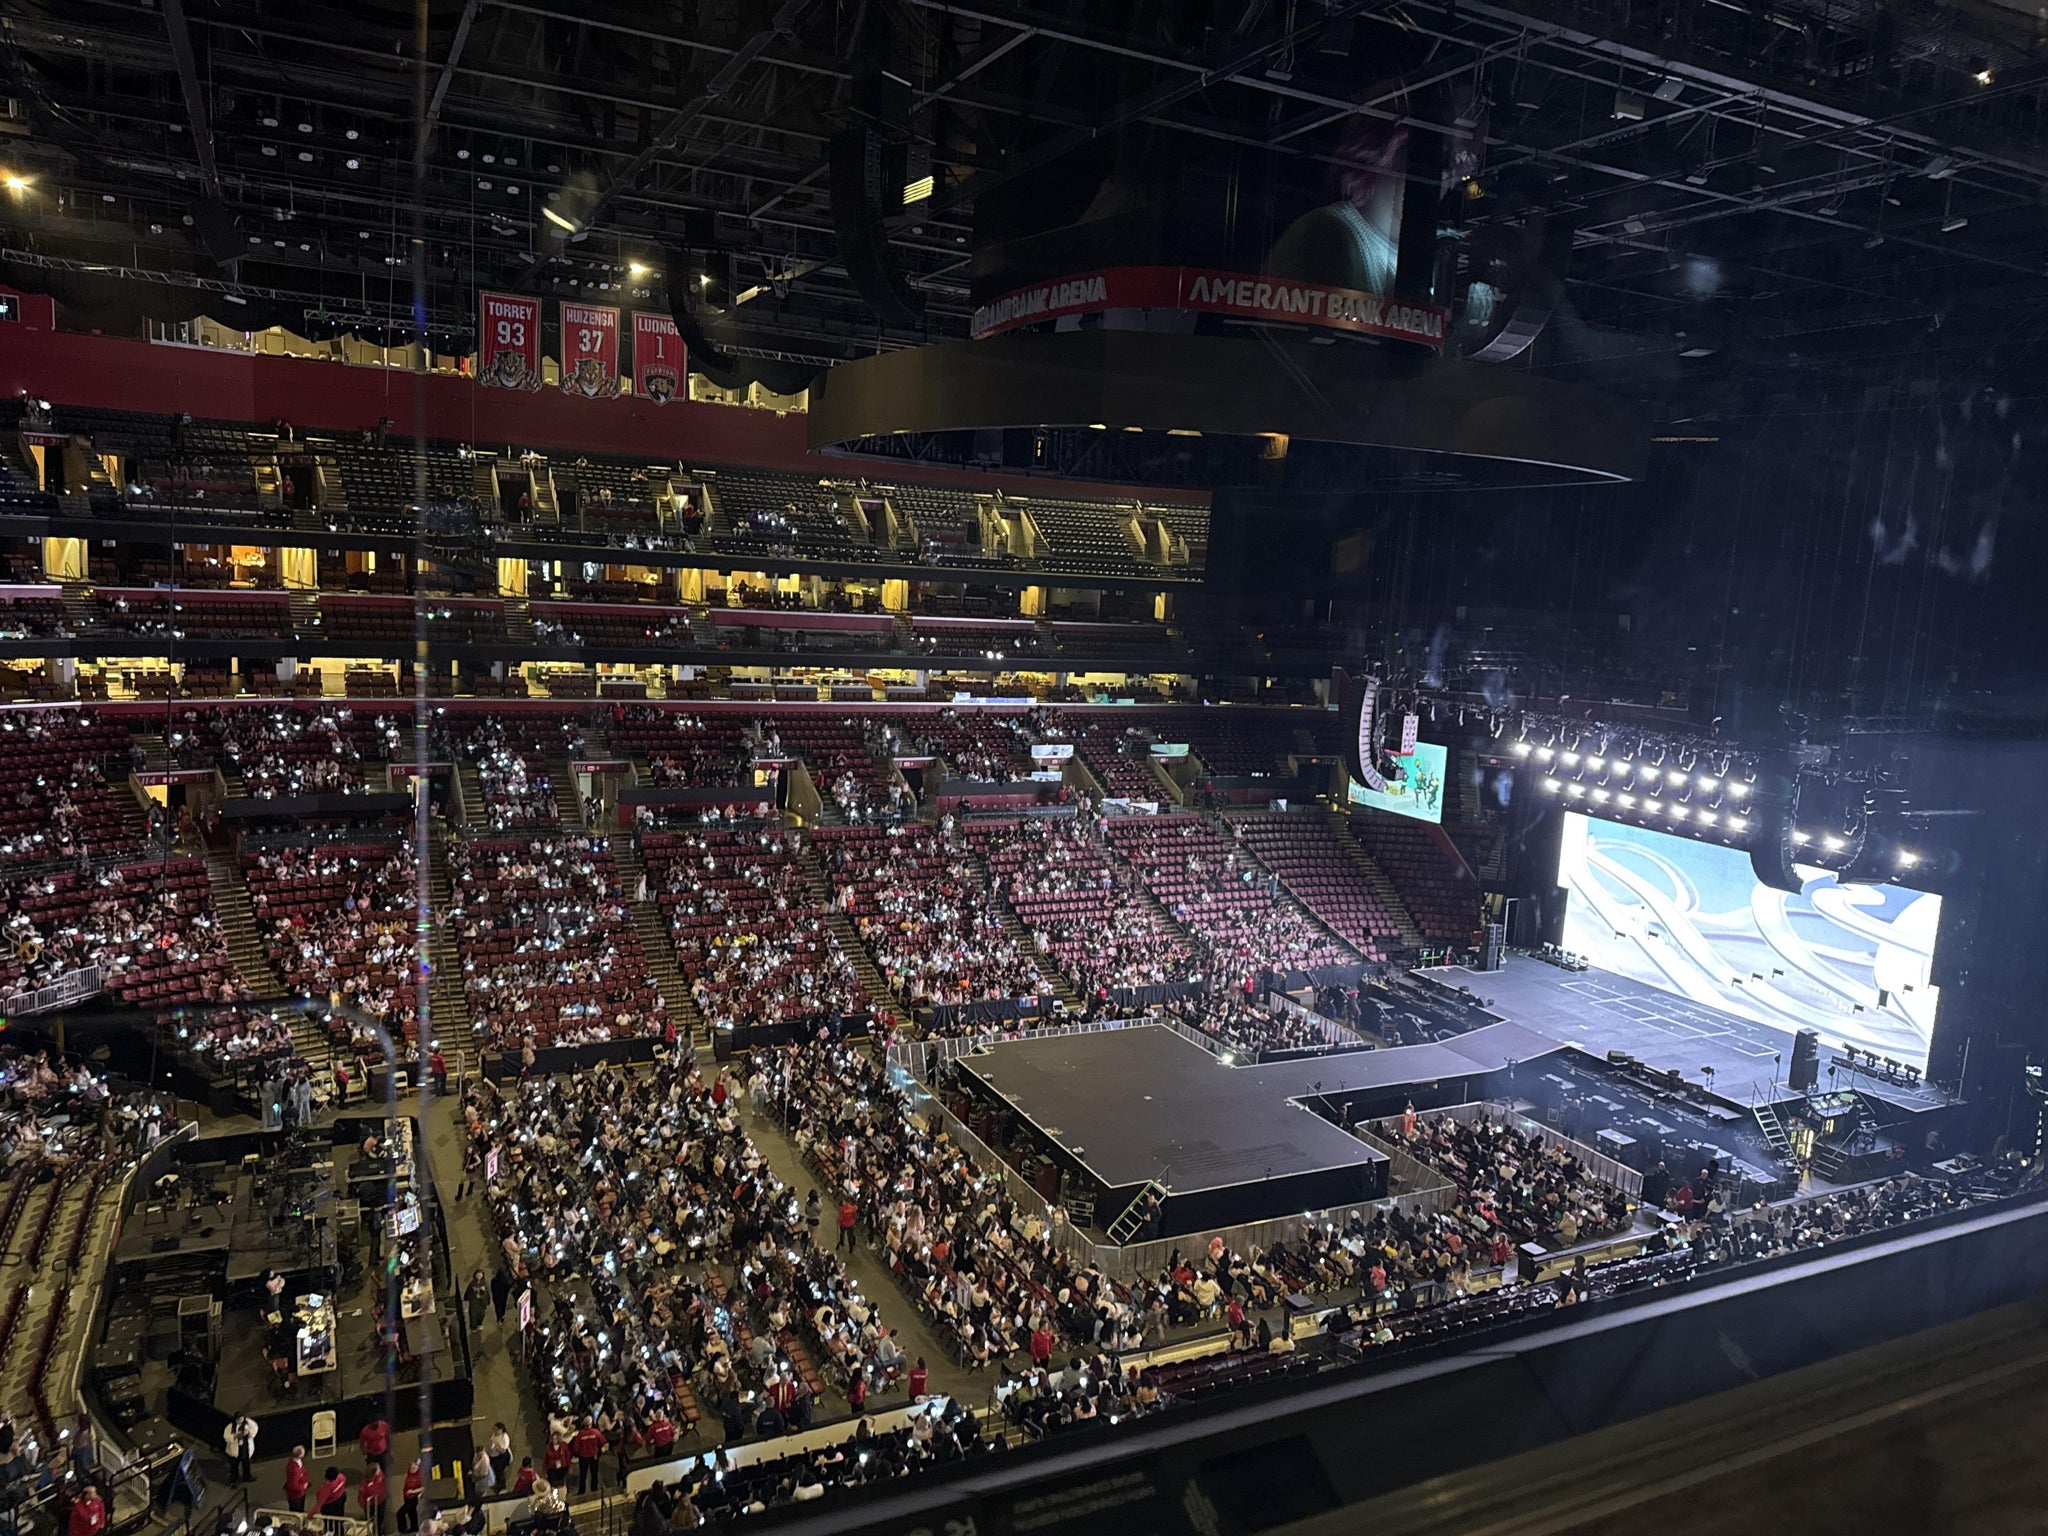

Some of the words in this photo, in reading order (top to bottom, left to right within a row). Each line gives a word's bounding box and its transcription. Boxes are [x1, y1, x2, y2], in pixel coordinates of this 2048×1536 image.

[1012, 288, 1050, 318] BANK
[1048, 276, 1107, 310] ARENA
[487, 301, 533, 320] TORREY
[1188, 276, 1326, 316] AMERANT
[1326, 293, 1385, 326] BANK
[1384, 304, 1443, 339] ARENA
[566, 308, 614, 328] HUIZENGA
[497, 320, 525, 346] 93
[578, 328, 604, 353] 37
[656, 335, 665, 359] 1
[646, 368, 675, 377] FLORIDA
[392, 767, 406, 776] 115
[575, 764, 587, 773] 116
[141, 776, 157, 785] 114
[490, 1159, 495, 1176] 5
